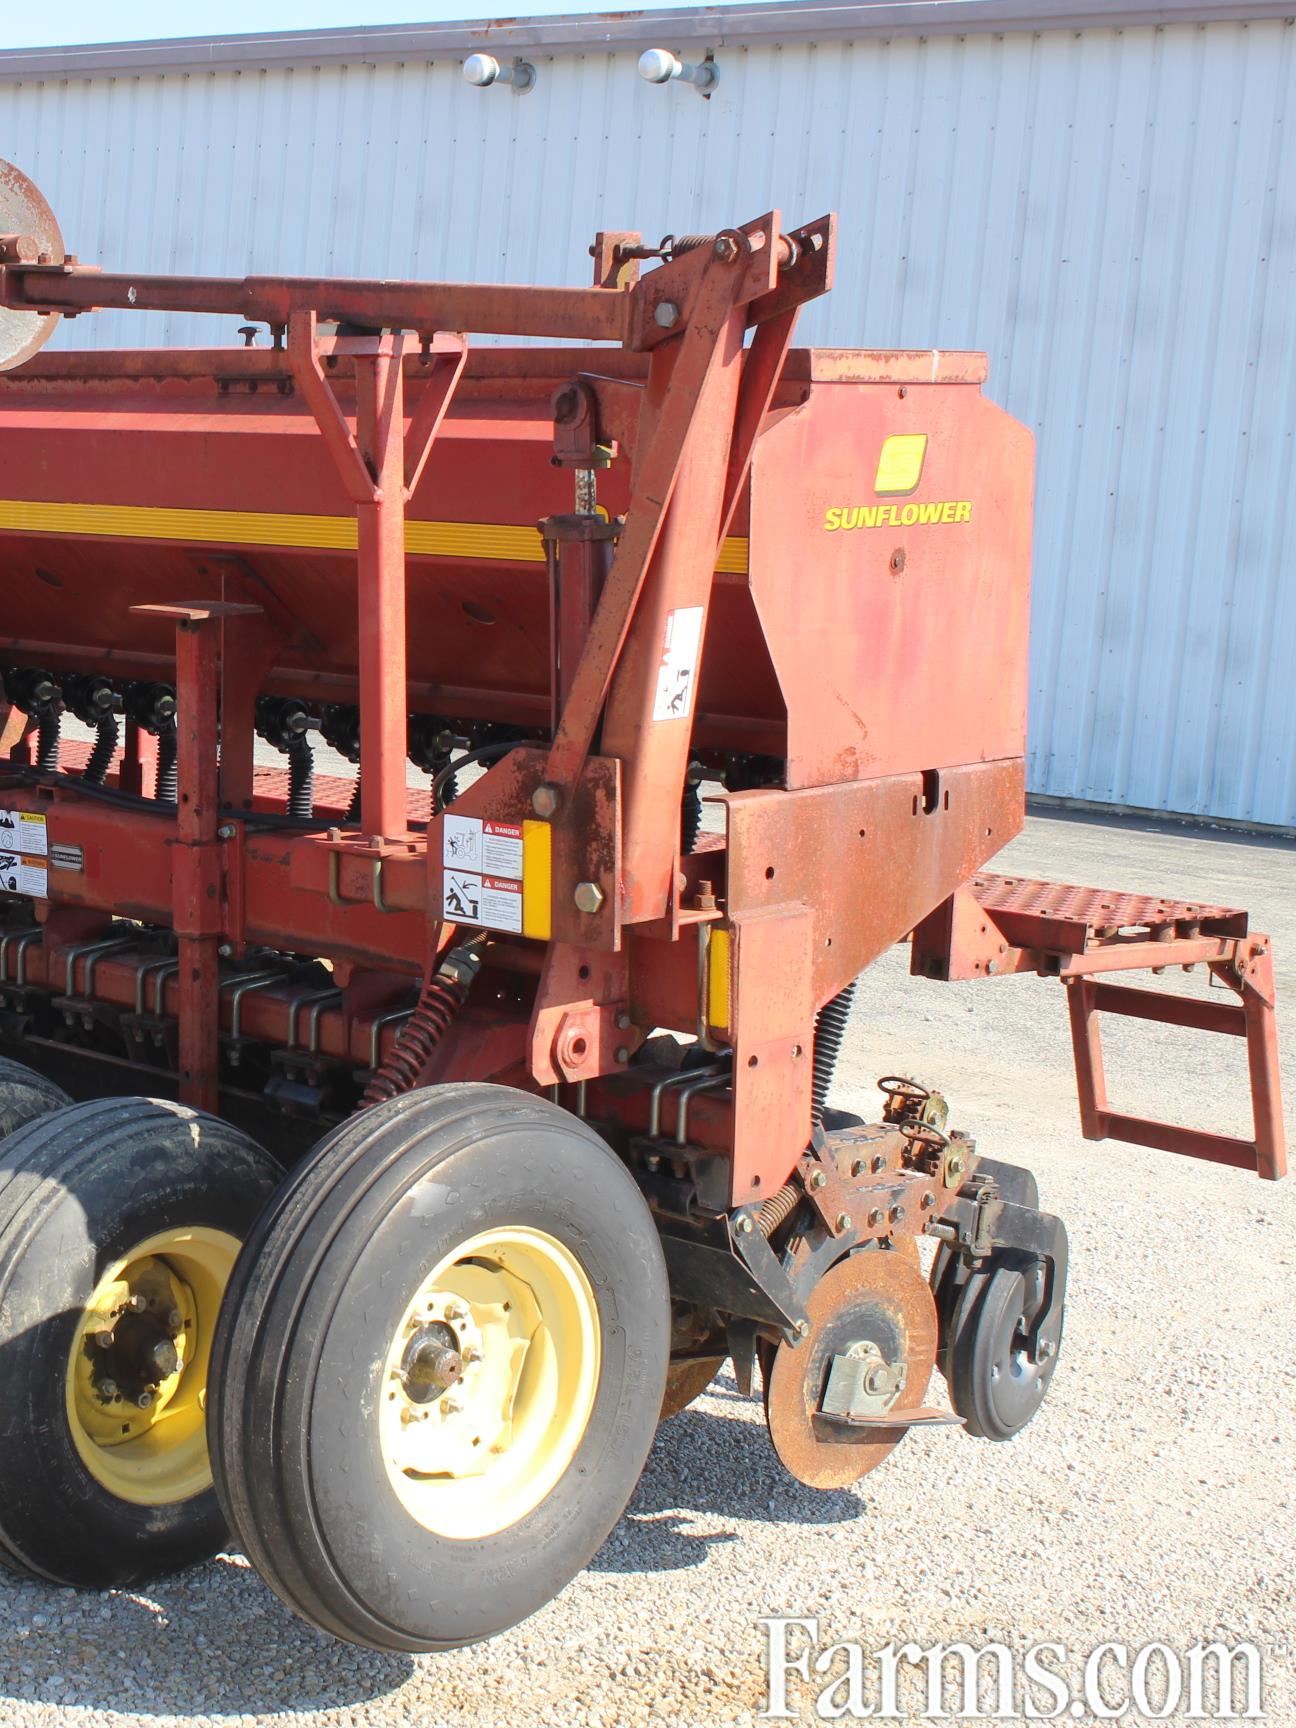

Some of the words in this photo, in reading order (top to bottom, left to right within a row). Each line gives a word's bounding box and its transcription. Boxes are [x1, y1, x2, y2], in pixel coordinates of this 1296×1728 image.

[824, 501, 972, 531] SUNFLOWER
[494, 826, 520, 836] DANGER
[494, 881, 518, 891] DANGER
